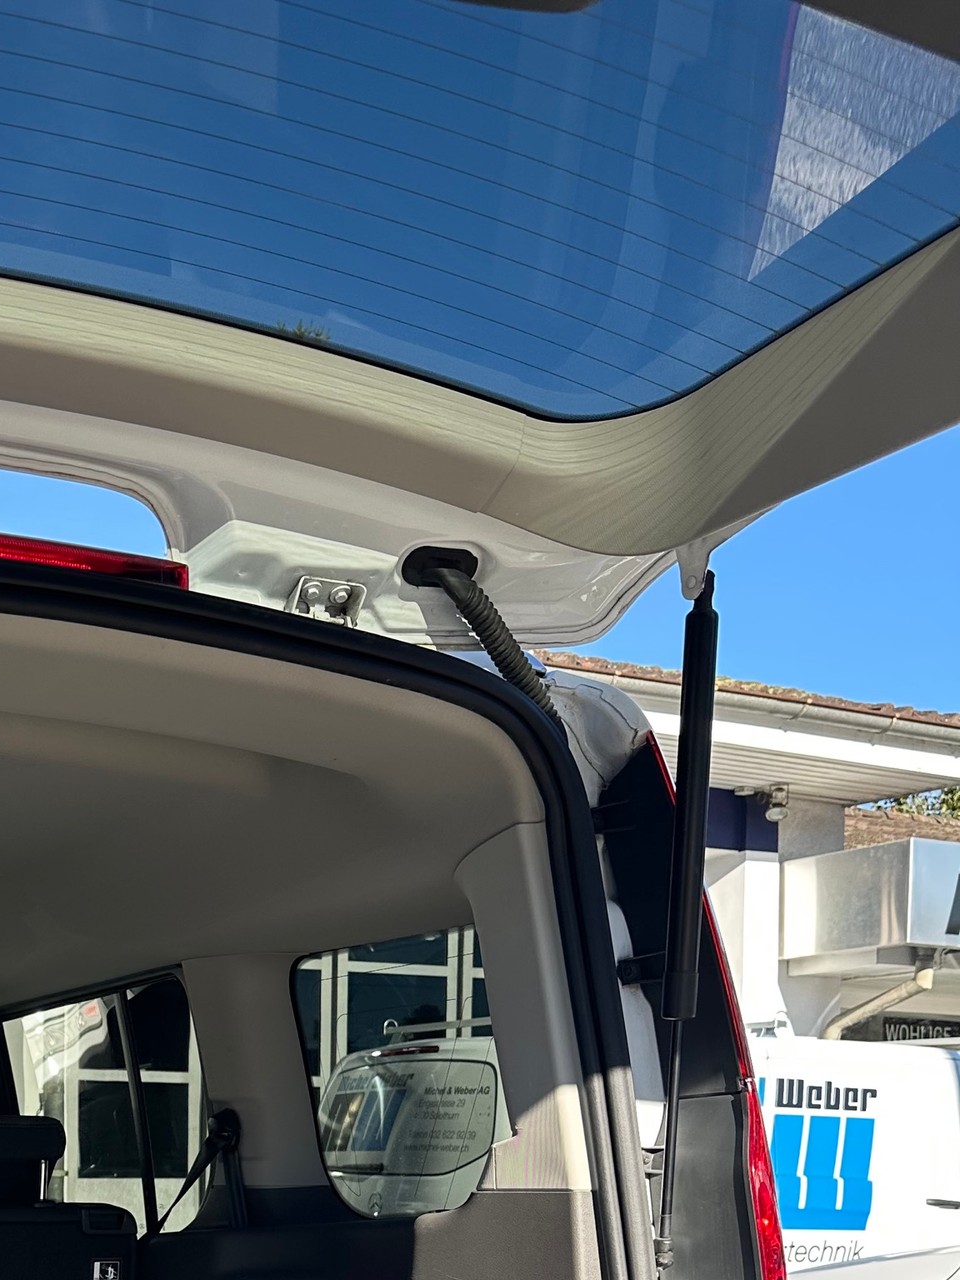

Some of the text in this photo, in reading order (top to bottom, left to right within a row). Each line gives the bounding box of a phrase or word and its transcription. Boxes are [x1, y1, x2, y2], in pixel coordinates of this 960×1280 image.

[454, 1086, 477, 1095] Weber
[478, 1086, 490, 1095] AG
[775, 1078, 877, 1111] Weber
[784, 1240, 864, 1262] technik
